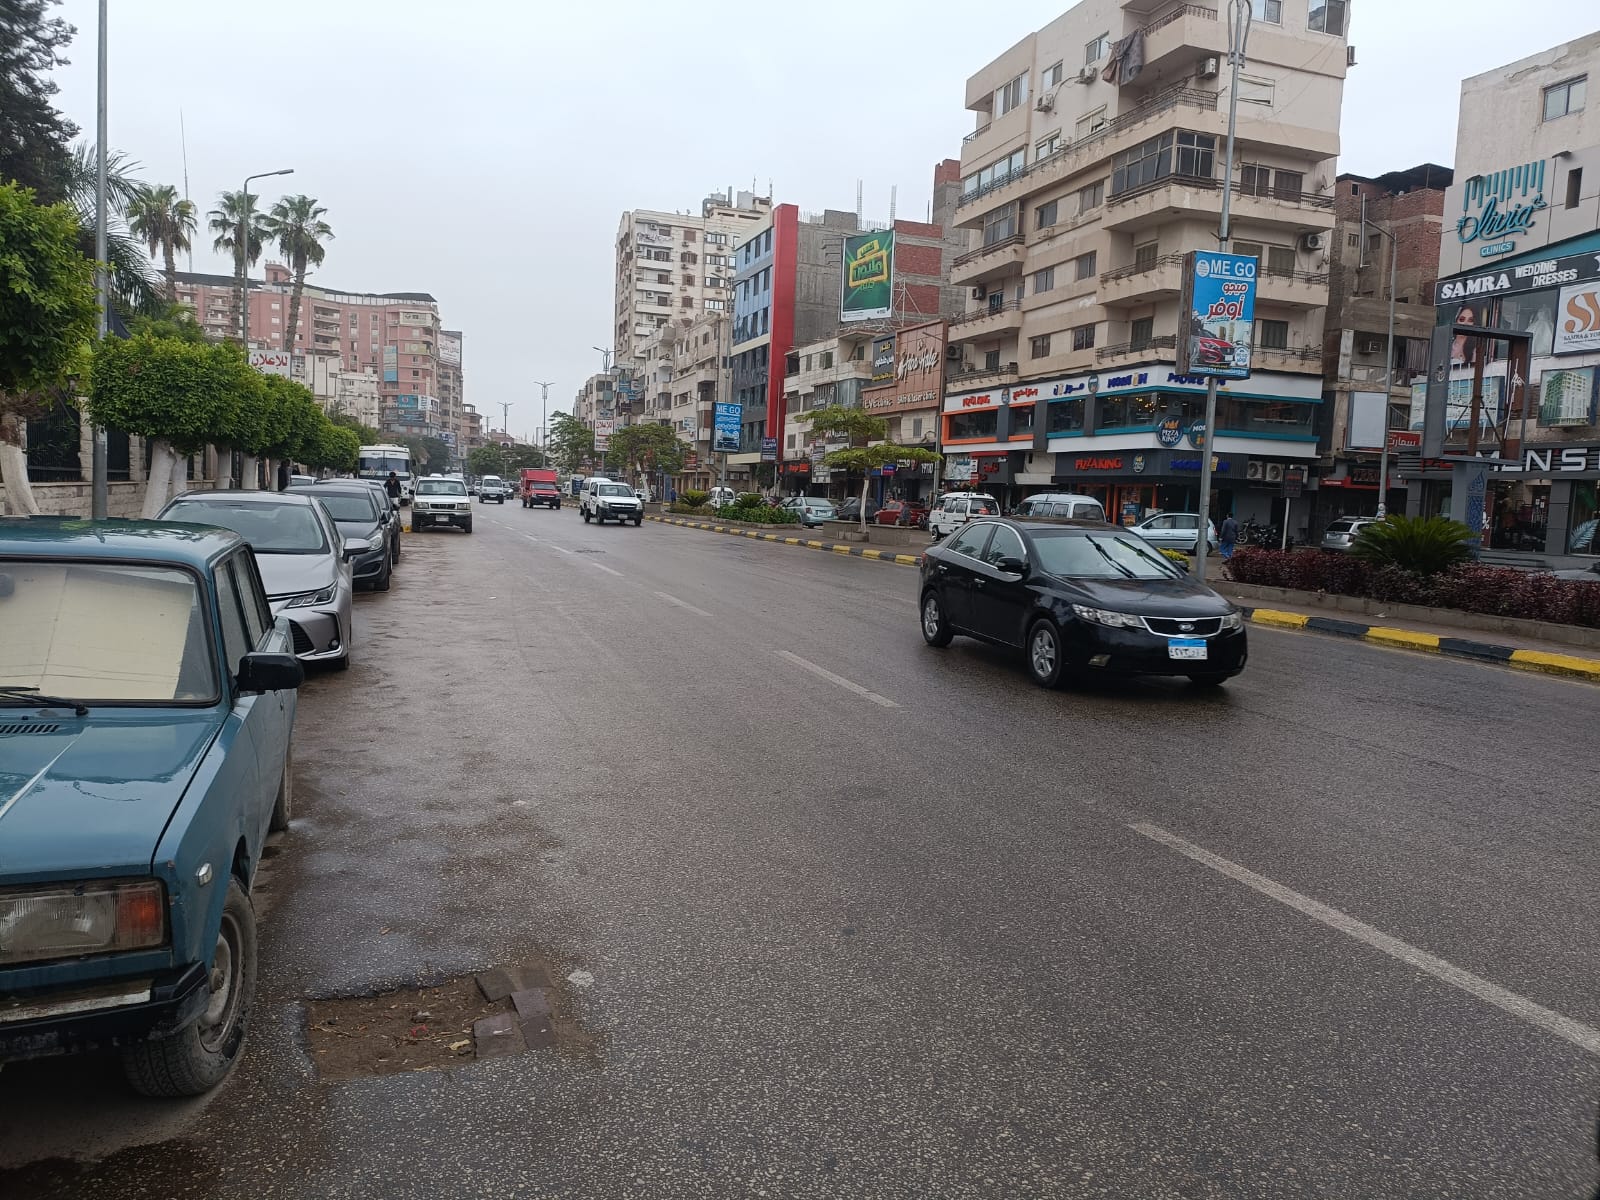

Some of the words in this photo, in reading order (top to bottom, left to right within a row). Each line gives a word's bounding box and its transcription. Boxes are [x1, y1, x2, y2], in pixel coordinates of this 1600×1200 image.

[1457, 196, 1536, 243] Olivia
[1481, 243, 1511, 256] CLINICS
[1211, 259, 1231, 275] ME
[1234, 262, 1256, 277] GO
[1515, 260, 1557, 278] WEDDING
[1441, 273, 1511, 299] SAMRA
[1532, 269, 1578, 287] DRESSES
[1162, 429, 1179, 437] PIZZA
